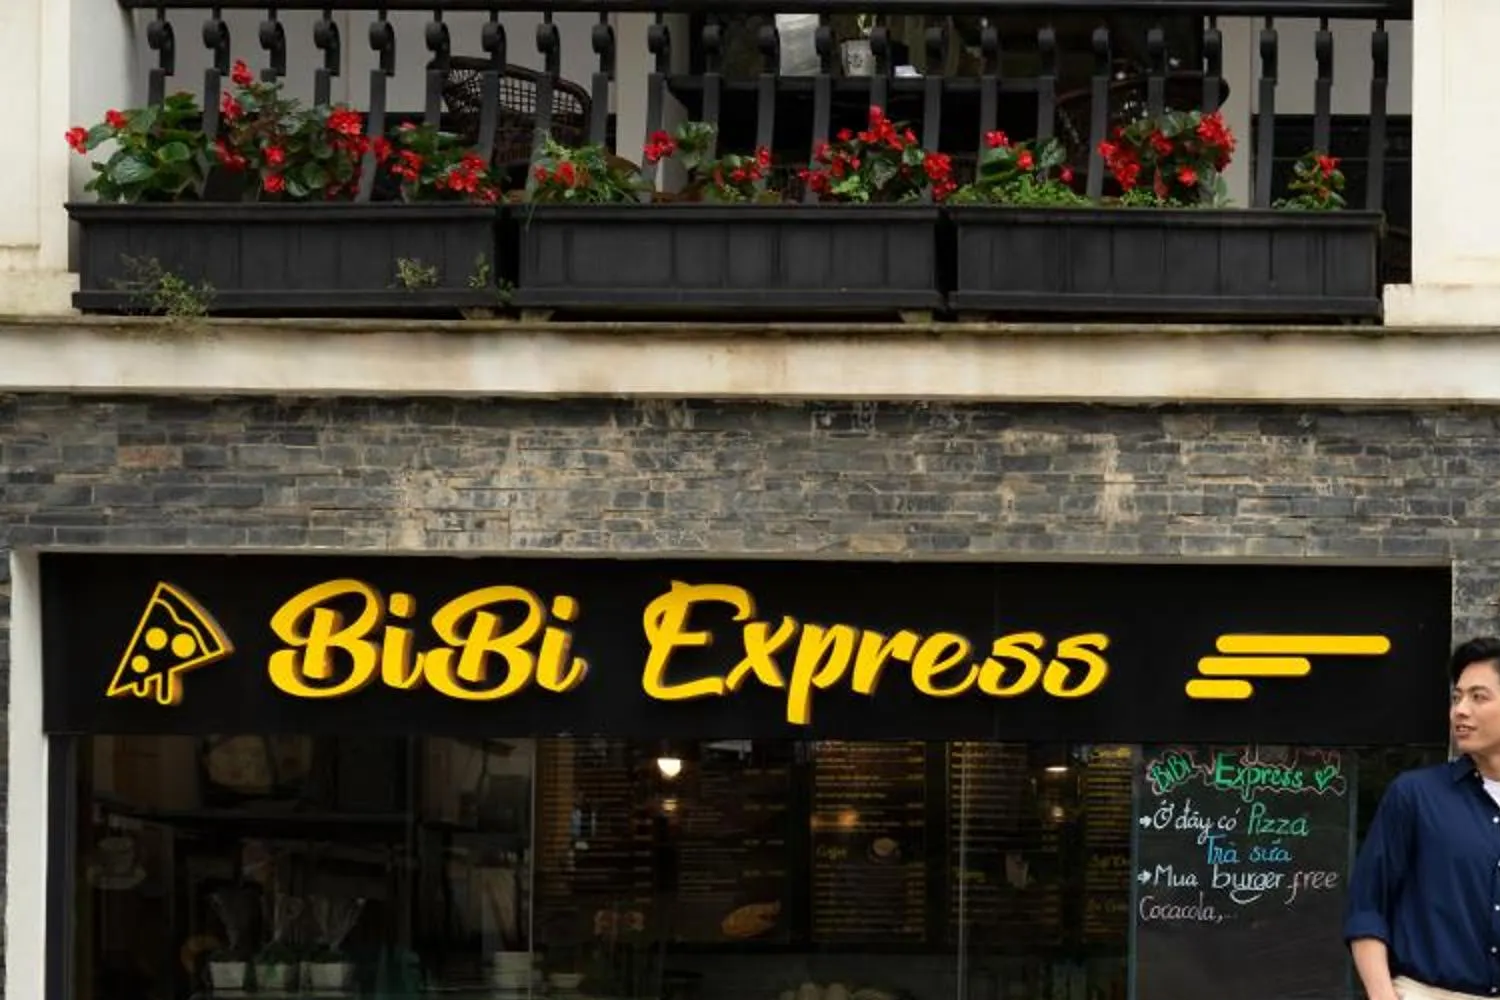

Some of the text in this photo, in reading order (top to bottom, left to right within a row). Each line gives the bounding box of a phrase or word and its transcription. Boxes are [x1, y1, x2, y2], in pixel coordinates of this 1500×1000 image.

[268, 579, 1110, 725] BiBi Express
[1215, 752, 1303, 799] Express
[1217, 807, 1240, 831] có
[1247, 801, 1310, 836] Pizza
[1153, 863, 1339, 905] Mua burger free
